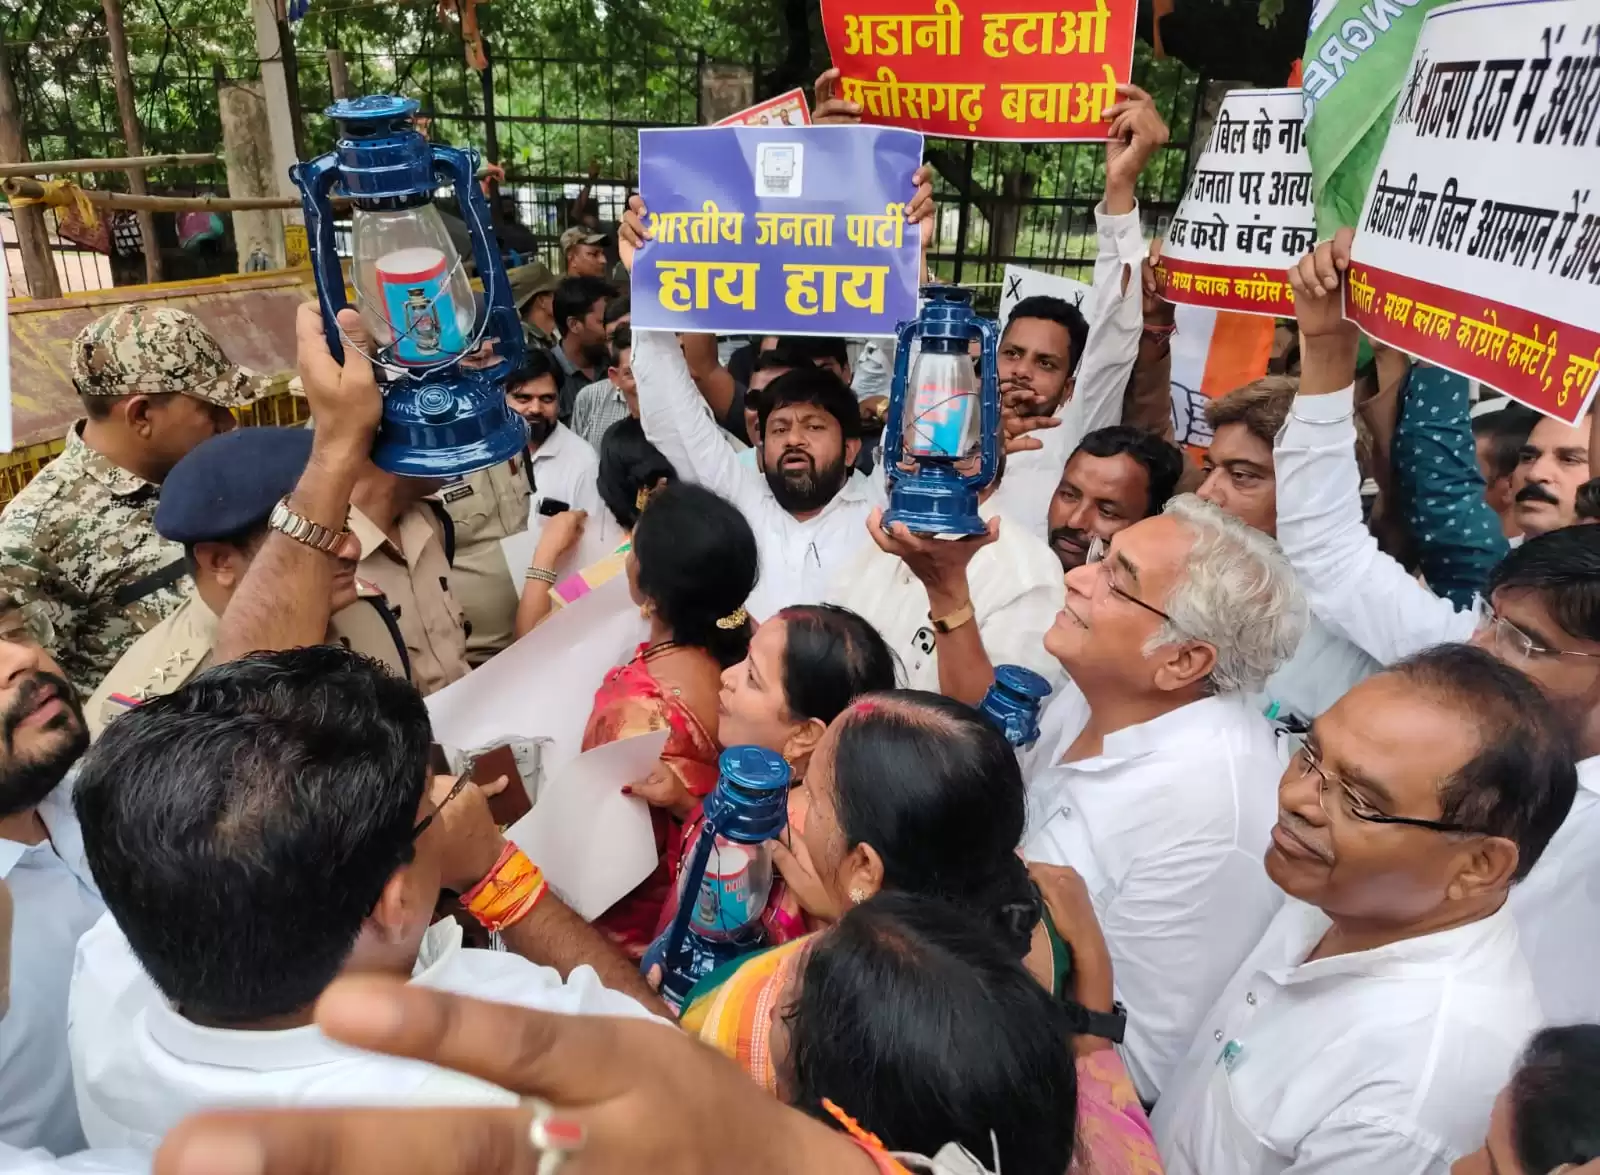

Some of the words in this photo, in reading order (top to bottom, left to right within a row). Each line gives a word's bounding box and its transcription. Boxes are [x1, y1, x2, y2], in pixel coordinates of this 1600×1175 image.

[844, 0, 963, 56] अडानी
[981, 0, 1112, 58] हटाओ
[841, 66, 985, 131] छत्तीसगढ़
[1000, 64, 1120, 123] बचाओ
[1414, 60, 1481, 138] भाजपा
[1466, 59, 1525, 142] राज
[1513, 24, 1566, 144] में
[1214, 109, 1250, 155] बिल
[1252, 107, 1273, 155] के
[1278, 118, 1307, 155] ना
[1194, 170, 1235, 205] जनता
[1239, 171, 1265, 205] पर
[1268, 171, 1314, 207] अत्य
[648, 200, 744, 245] भारतीय
[755, 213, 834, 247] जनता
[846, 202, 905, 249] पार्टी
[1190, 212, 1229, 252] करो
[1236, 213, 1277, 255] बंद
[1364, 169, 1417, 241] बिजली
[1408, 191, 1438, 246] का
[1428, 177, 1478, 254] बिल
[1467, 200, 1560, 271] आसमान
[1548, 188, 1591, 275] में
[656, 261, 760, 312] हाय
[783, 263, 890, 316] हाय
[1172, 271, 1193, 293] मध्य
[1194, 275, 1231, 297] ब्लाक
[1233, 271, 1283, 303] कांग्रेस
[1411, 302, 1457, 342] ब्लाक
[1455, 307, 1509, 362] कांग्रेस
